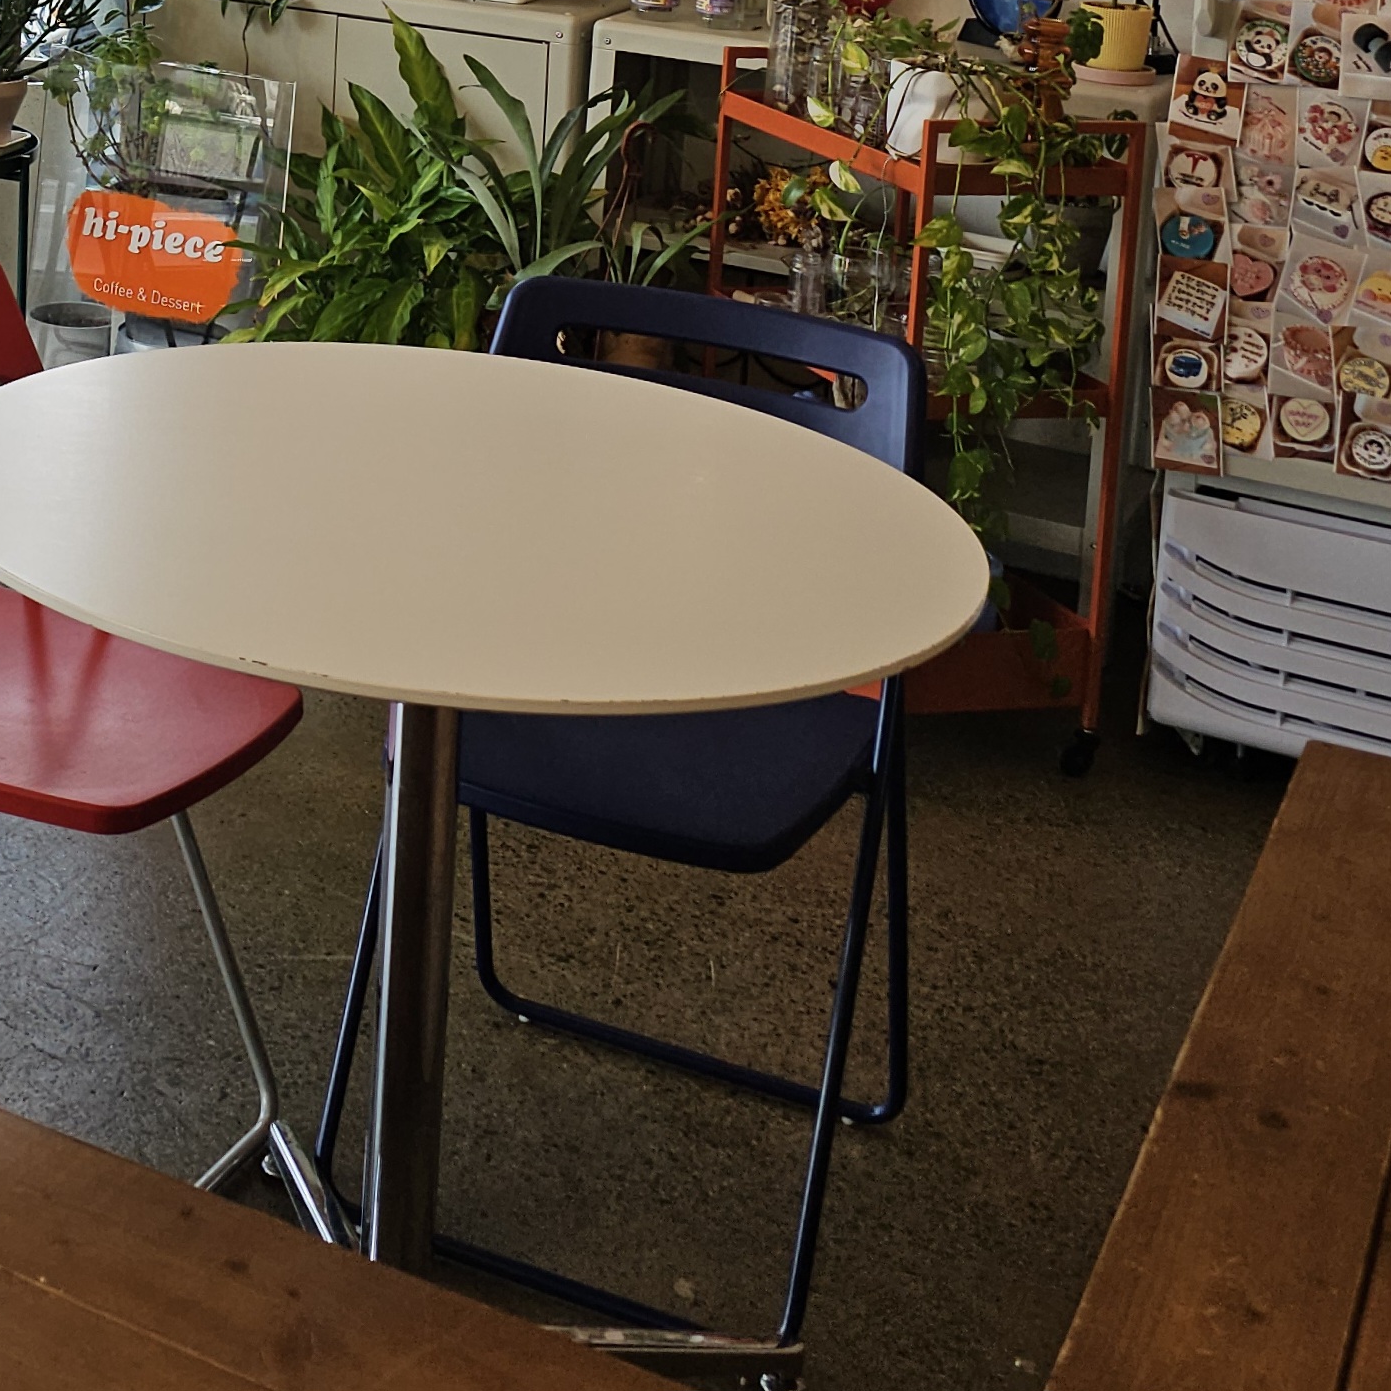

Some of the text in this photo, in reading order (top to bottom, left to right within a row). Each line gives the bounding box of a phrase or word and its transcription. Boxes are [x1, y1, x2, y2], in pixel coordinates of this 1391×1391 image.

[82, 206, 226, 263] hi-piece
[93, 277, 204, 314] Coffee & Dessert
